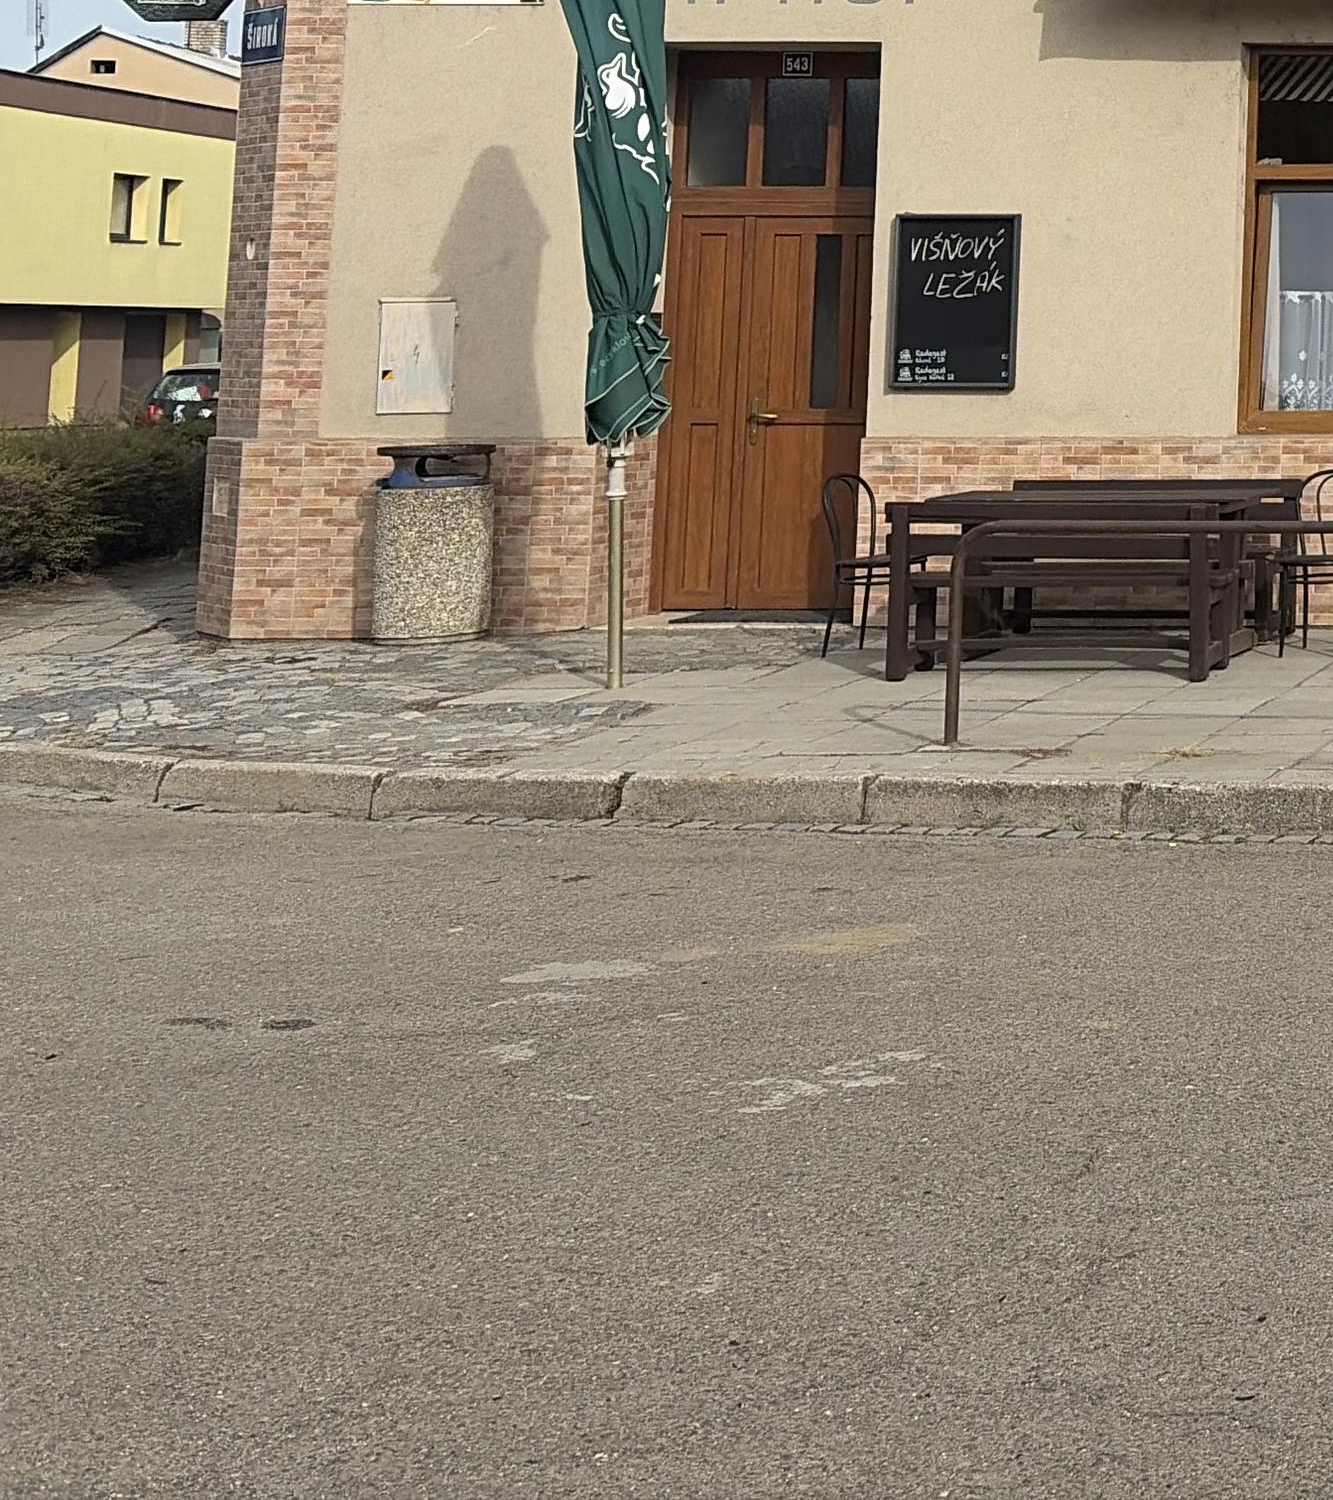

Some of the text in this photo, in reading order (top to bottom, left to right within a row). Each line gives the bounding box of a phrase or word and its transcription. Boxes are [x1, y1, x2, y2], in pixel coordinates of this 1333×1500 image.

[786, 56, 809, 72] 543
[911, 228, 1005, 262] VIŠŇOVÝ
[922, 261, 1005, 299] LEŽÁK
